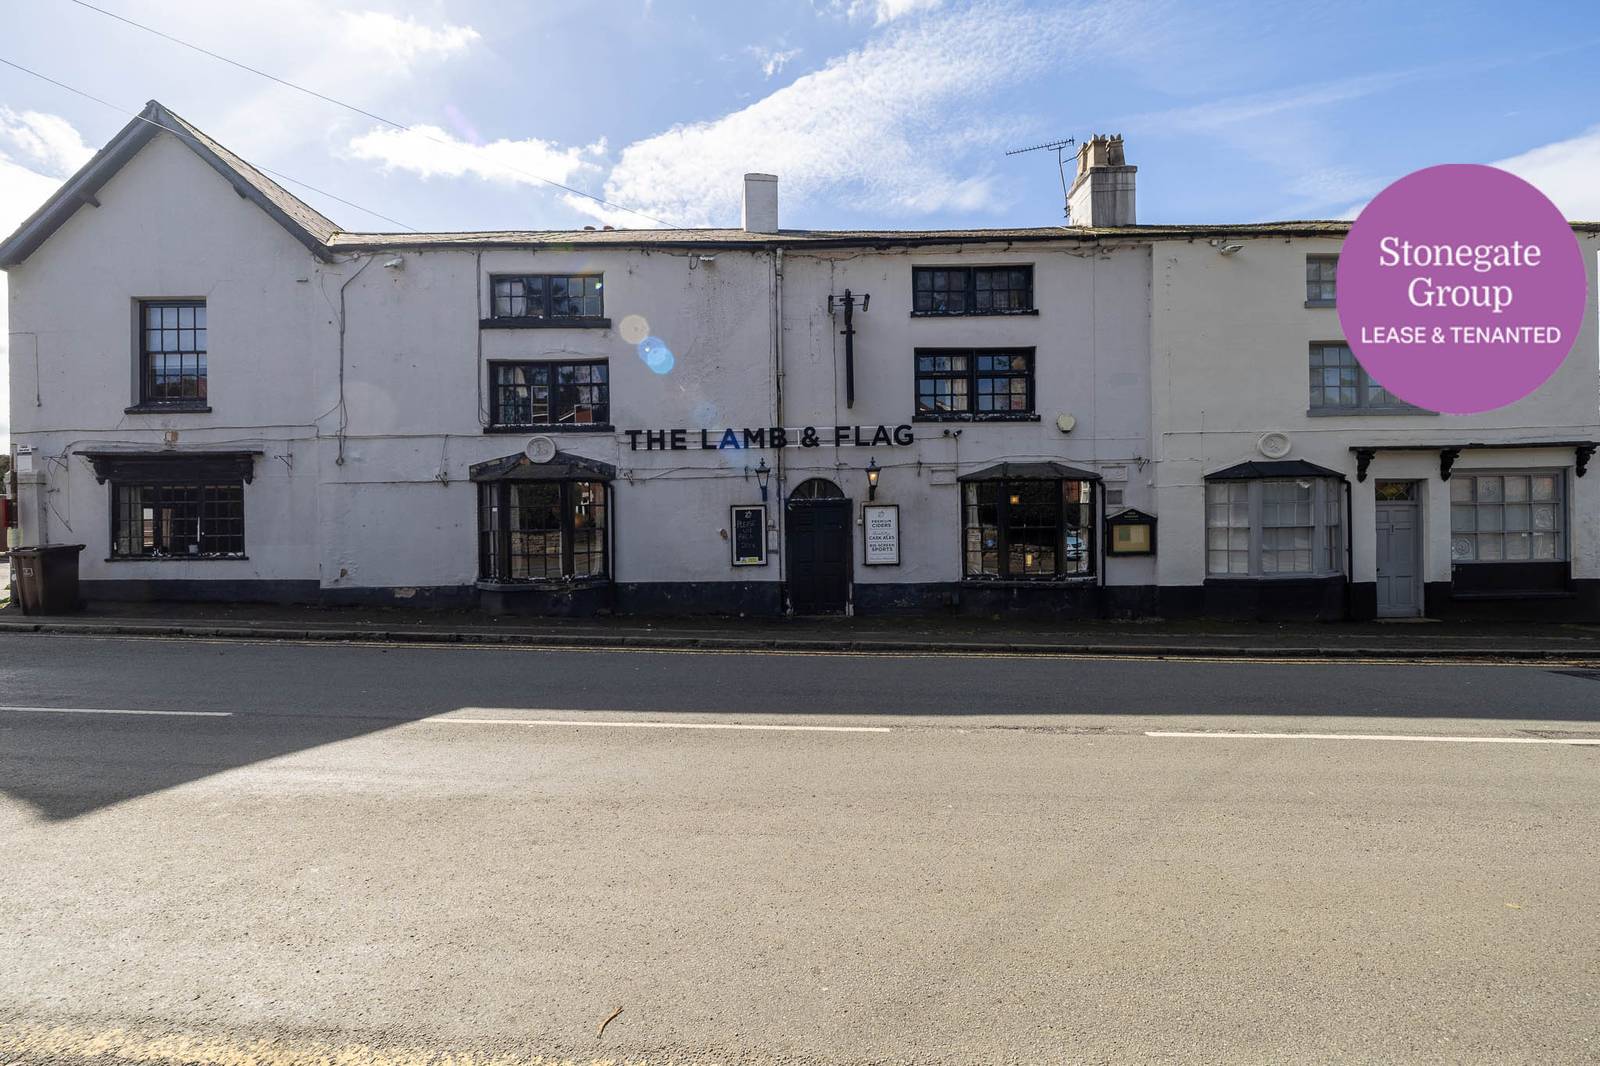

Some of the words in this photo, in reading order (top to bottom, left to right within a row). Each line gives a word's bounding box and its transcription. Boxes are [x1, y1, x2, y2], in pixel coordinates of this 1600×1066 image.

[625, 429, 687, 450] THE
[701, 427, 788, 450] LAMB
[801, 426, 820, 448] &
[834, 424, 914, 447] FLAG
